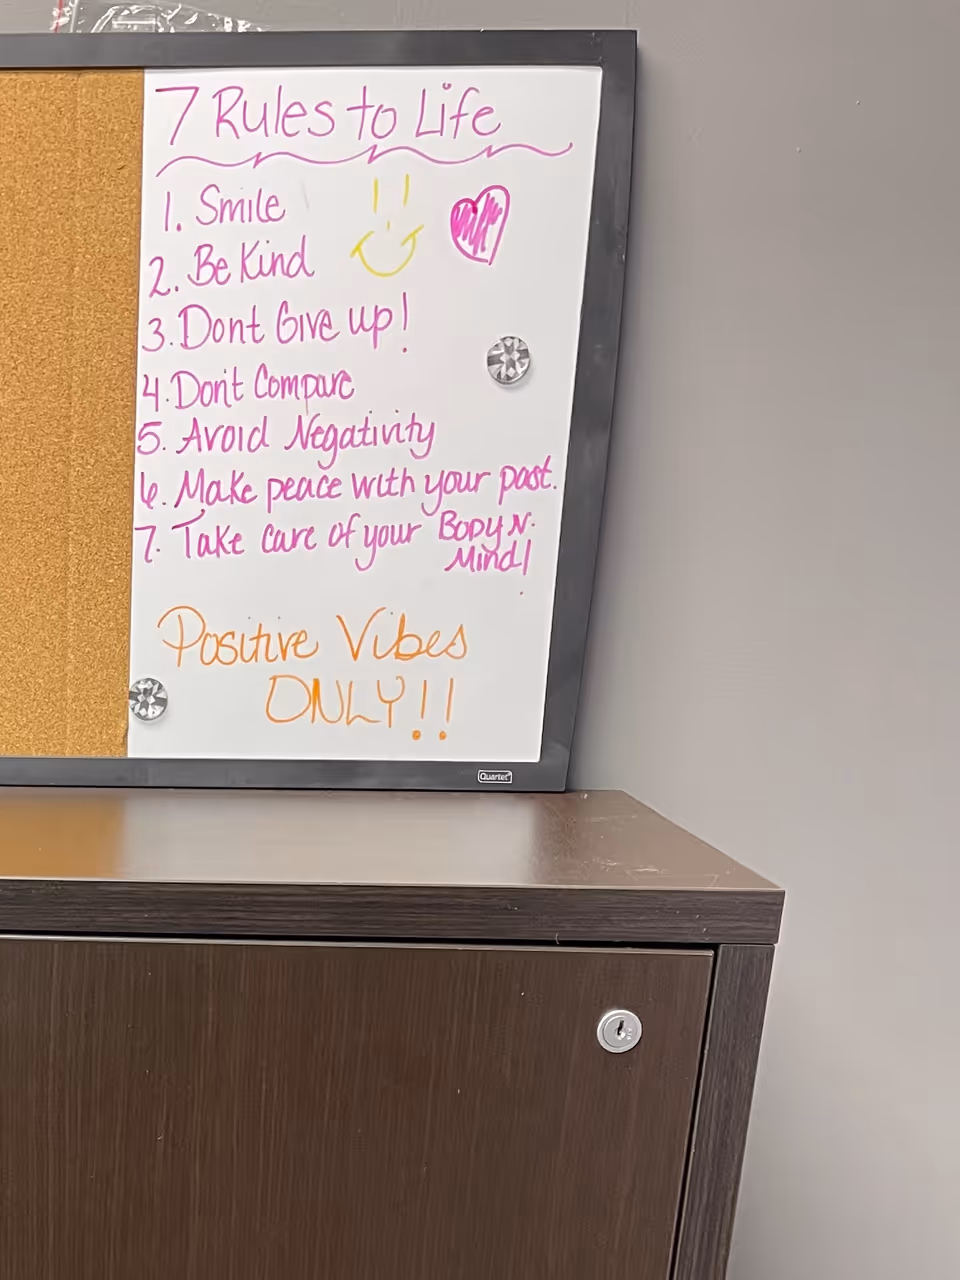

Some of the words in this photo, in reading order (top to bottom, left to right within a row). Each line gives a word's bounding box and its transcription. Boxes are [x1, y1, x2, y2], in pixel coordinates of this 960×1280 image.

[155, 86, 200, 146] 7
[212, 84, 337, 140] Rules
[346, 85, 398, 141] to
[414, 82, 502, 139] Life
[163, 191, 182, 231] 1.
[195, 184, 286, 226] Smile
[148, 256, 180, 298] 2.
[187, 243, 231, 286] Be
[239, 234, 316, 282] Kind
[141, 317, 173, 352] 3.
[276, 300, 340, 342] Give
[348, 292, 409, 354] up!
[142, 373, 170, 412] 4.
[136, 420, 167, 456] 5.
[175, 415, 271, 455] Avoid
[283, 408, 437, 470] Negativity
[138, 471, 167, 509] 6.
[173, 468, 259, 510] Make
[266, 471, 343, 514] peace
[350, 466, 416, 499] with
[420, 469, 491, 517] your
[498, 455, 559, 507] past.
[133, 524, 161, 564] 7.
[171, 509, 246, 560] Take
[327, 512, 362, 550] of
[354, 521, 422, 573] your
[156, 604, 320, 668] Positive
[335, 606, 470, 662] Vibes
[264, 673, 456, 742] ONLY!!
